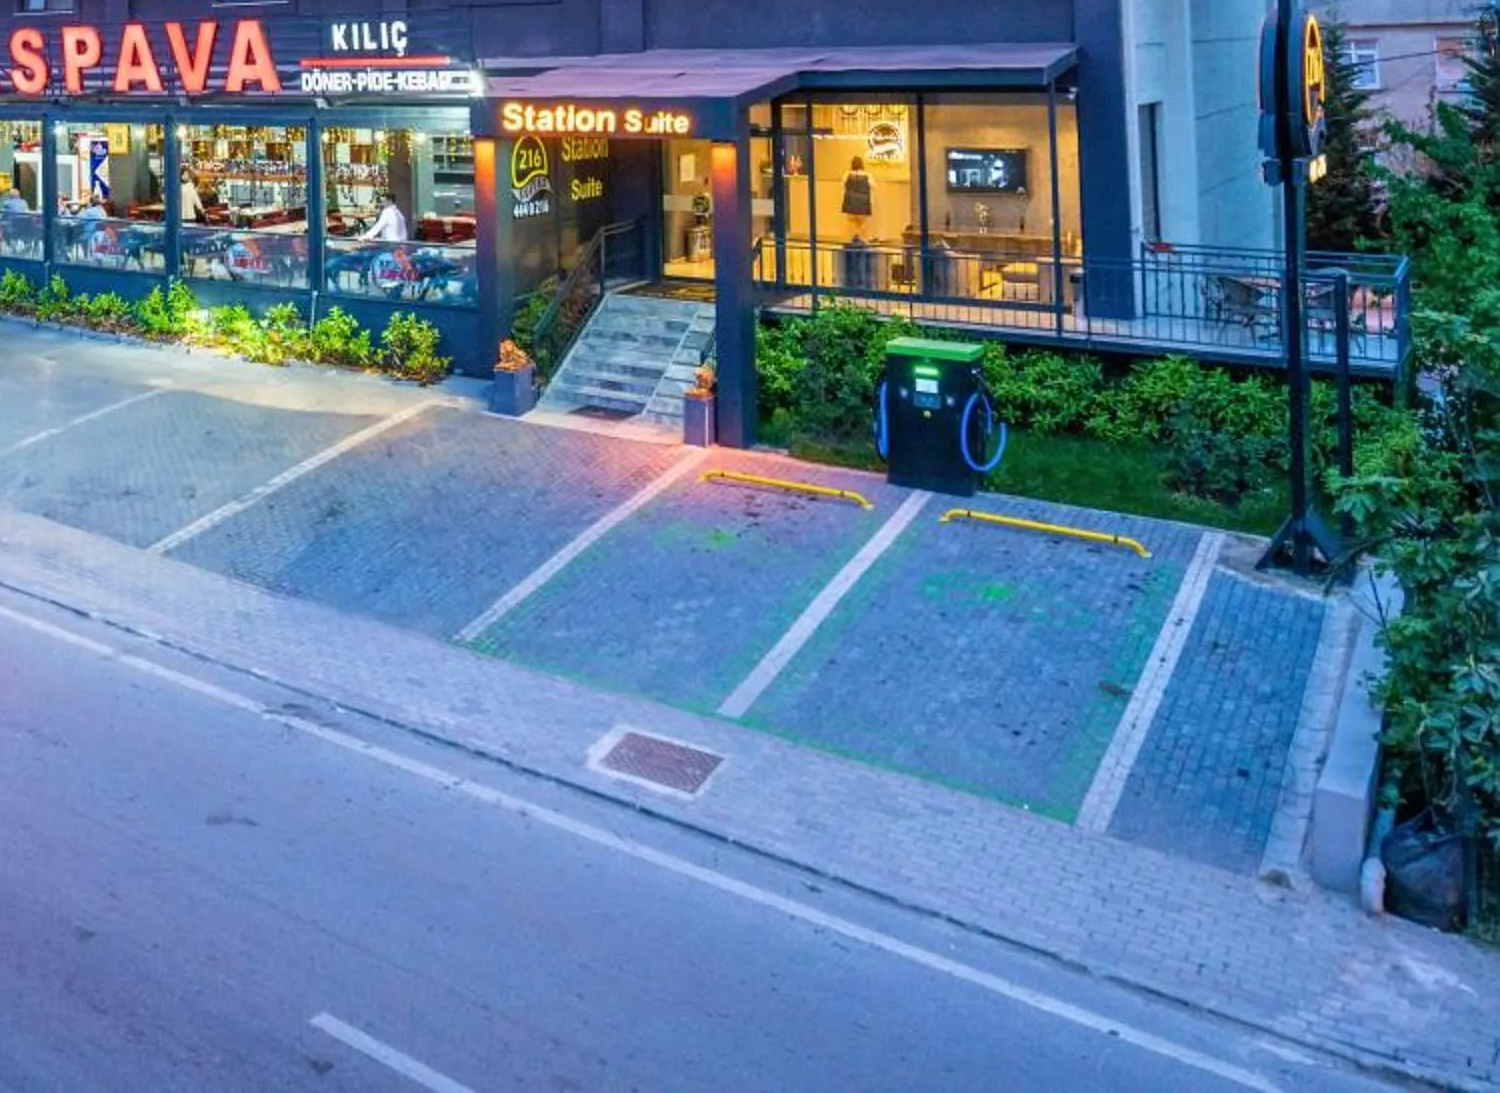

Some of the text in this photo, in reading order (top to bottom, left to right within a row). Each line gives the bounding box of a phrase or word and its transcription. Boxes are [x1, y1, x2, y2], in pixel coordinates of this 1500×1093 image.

[332, 20, 408, 57] KILIÇ
[502, 102, 690, 134] Station Suite
[519, 149, 541, 169] 216
[571, 176, 603, 201] Suite
